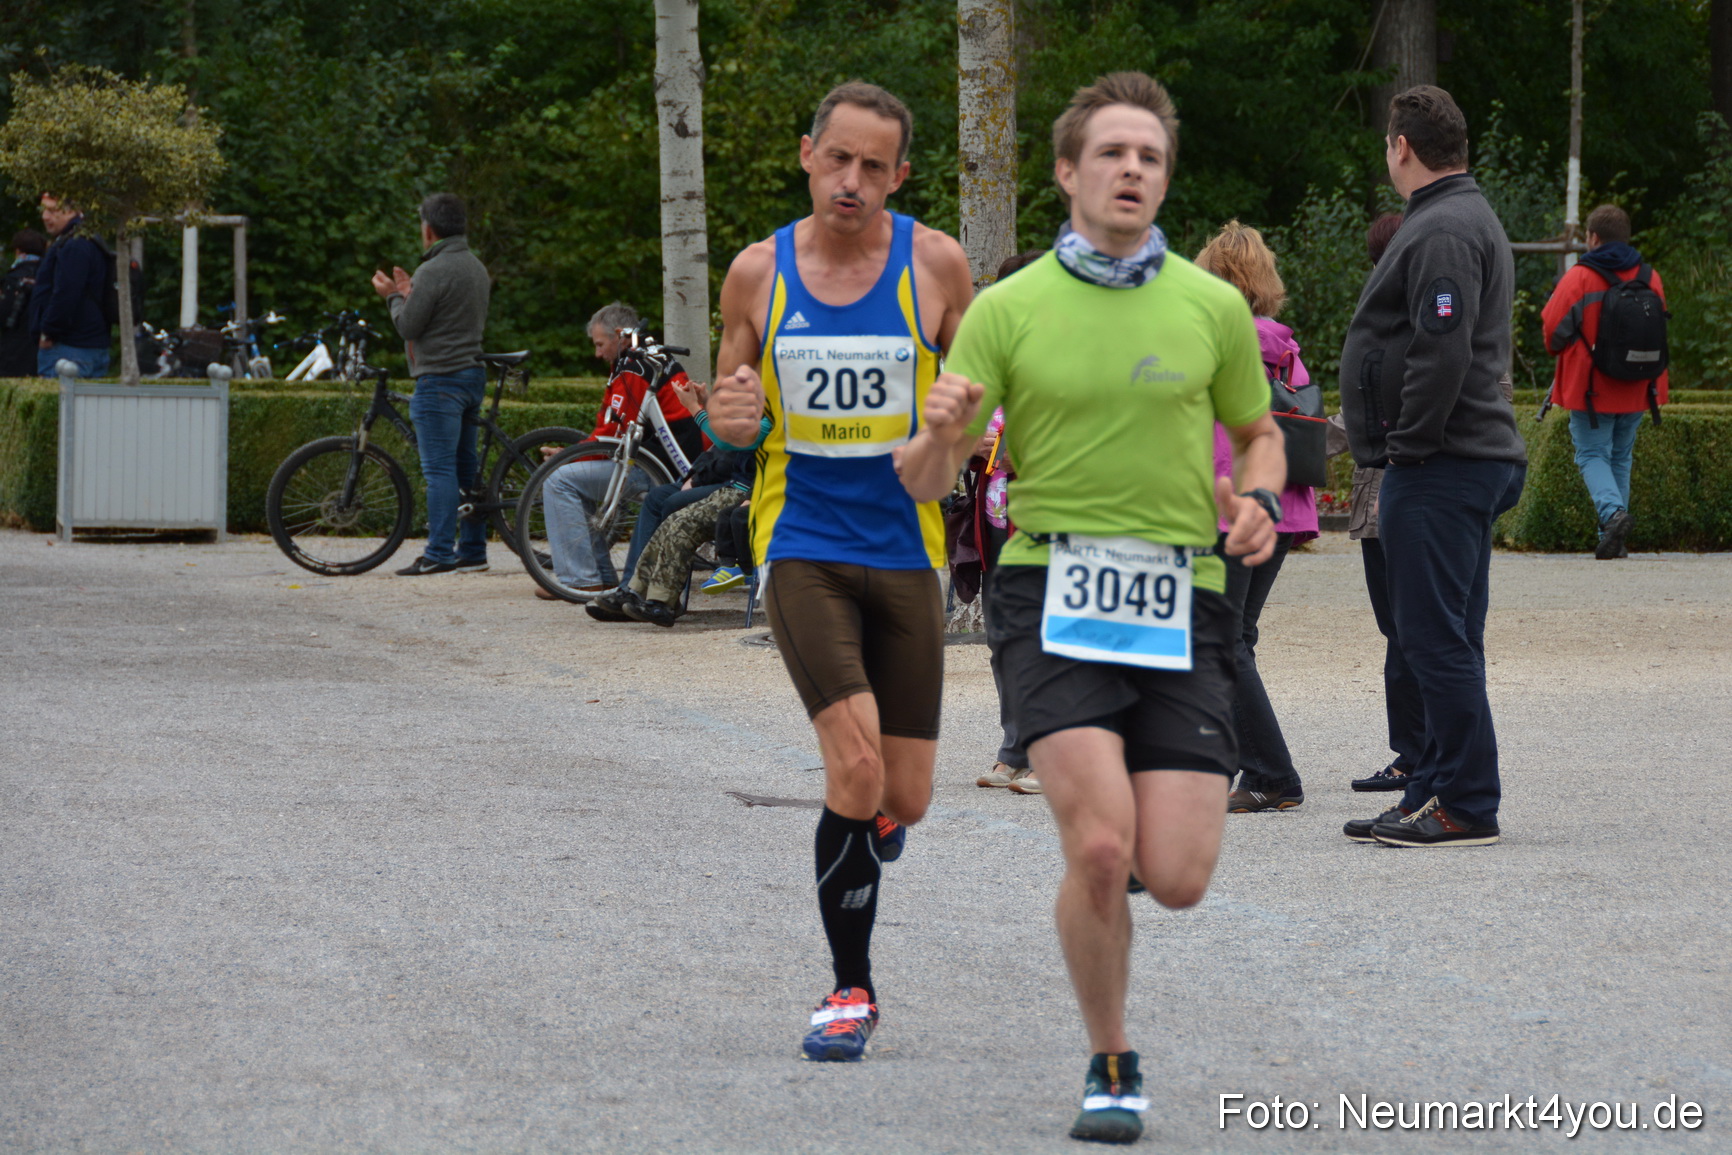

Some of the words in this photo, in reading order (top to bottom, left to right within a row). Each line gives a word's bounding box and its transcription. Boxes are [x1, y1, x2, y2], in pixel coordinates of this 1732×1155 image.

[779, 350, 821, 361] PARTL
[827, 349, 889, 361] Neumarkt
[806, 367, 887, 410] 203
[821, 423, 872, 440] Mario
[658, 426, 689, 474] KETTLER
[1054, 542, 1101, 559] PARTL
[1105, 547, 1169, 565] Neumarkt
[1063, 564, 1177, 620] 3049
